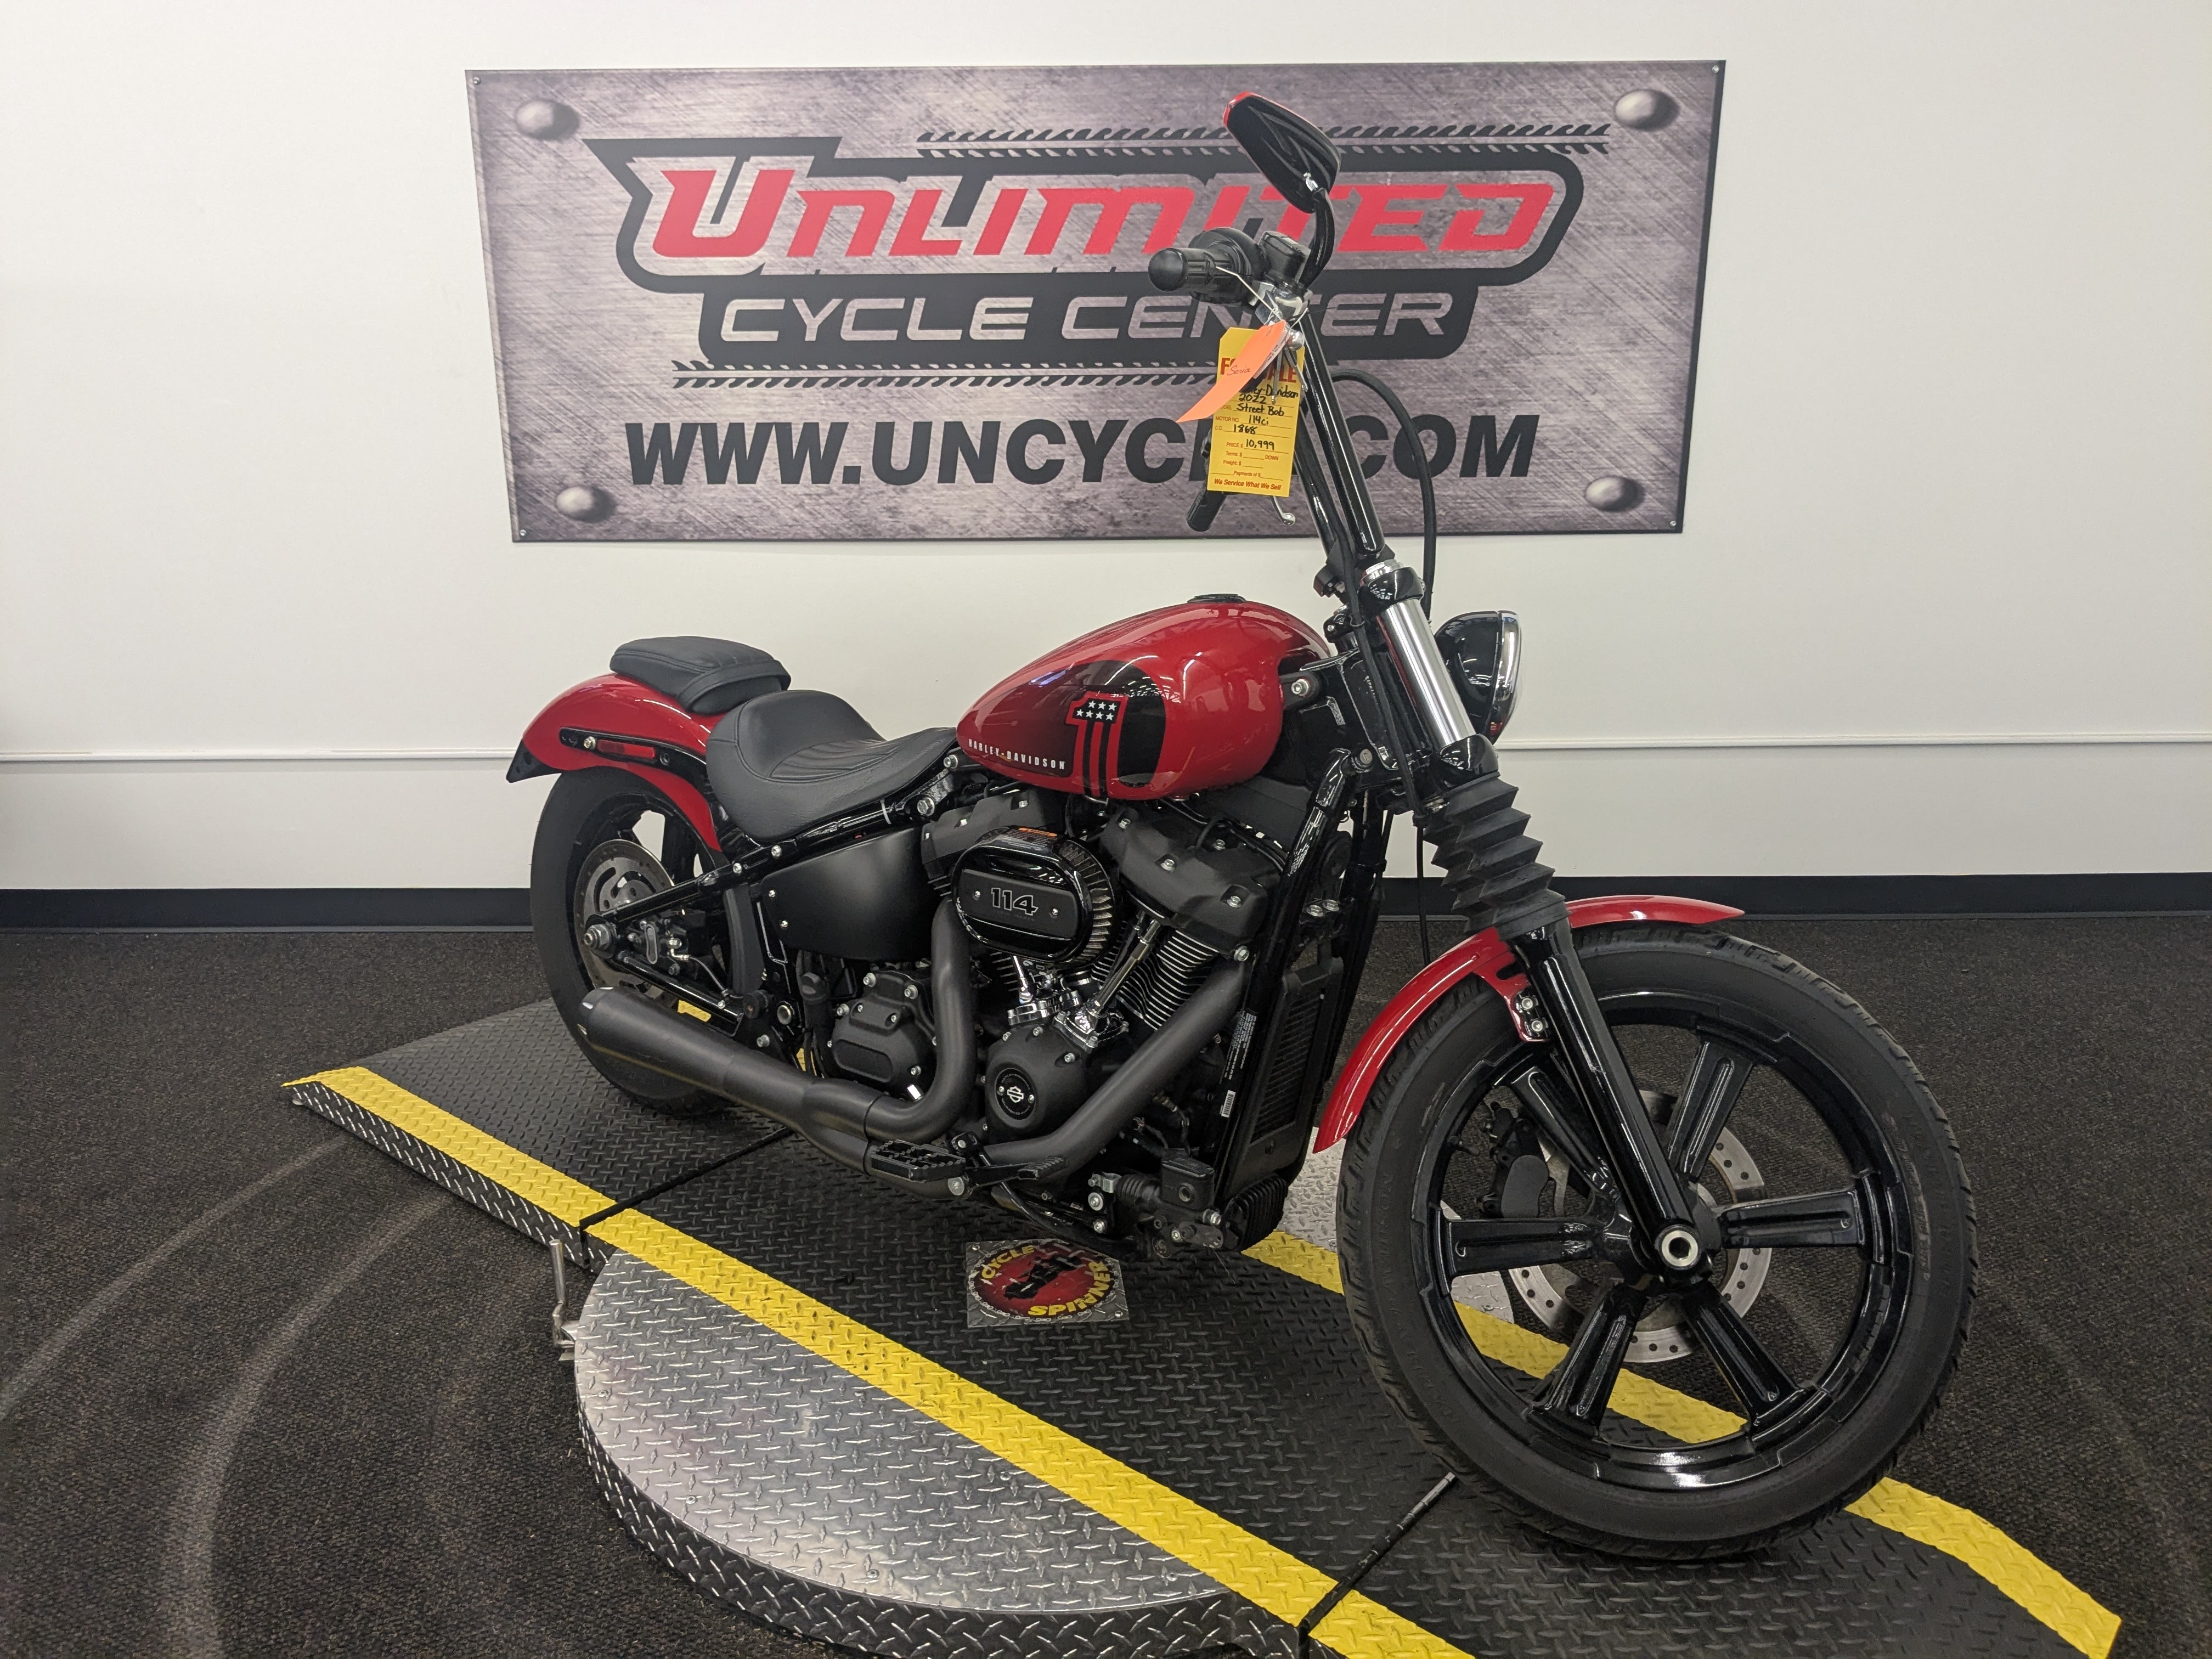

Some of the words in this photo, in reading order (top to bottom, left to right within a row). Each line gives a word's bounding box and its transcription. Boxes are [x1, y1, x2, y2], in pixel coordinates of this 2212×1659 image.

[652, 168, 1555, 258] UNLIMITED
[720, 297, 1034, 341] CYCLE
[1061, 293, 1453, 340] CENER
[1236, 403, 1265, 413] Street
[1267, 405, 1285, 416] Bob
[1239, 393, 1267, 404] 2022
[1233, 424, 1258, 435] 1868
[1245, 438, 1275, 451] 10,999
[968, 738, 1065, 770] HARLEY-DAVIDSON
[991, 887, 1039, 916] 114
[981, 1245, 1035, 1279] CYCLE
[1028, 1261, 1111, 1316] SPINNER
